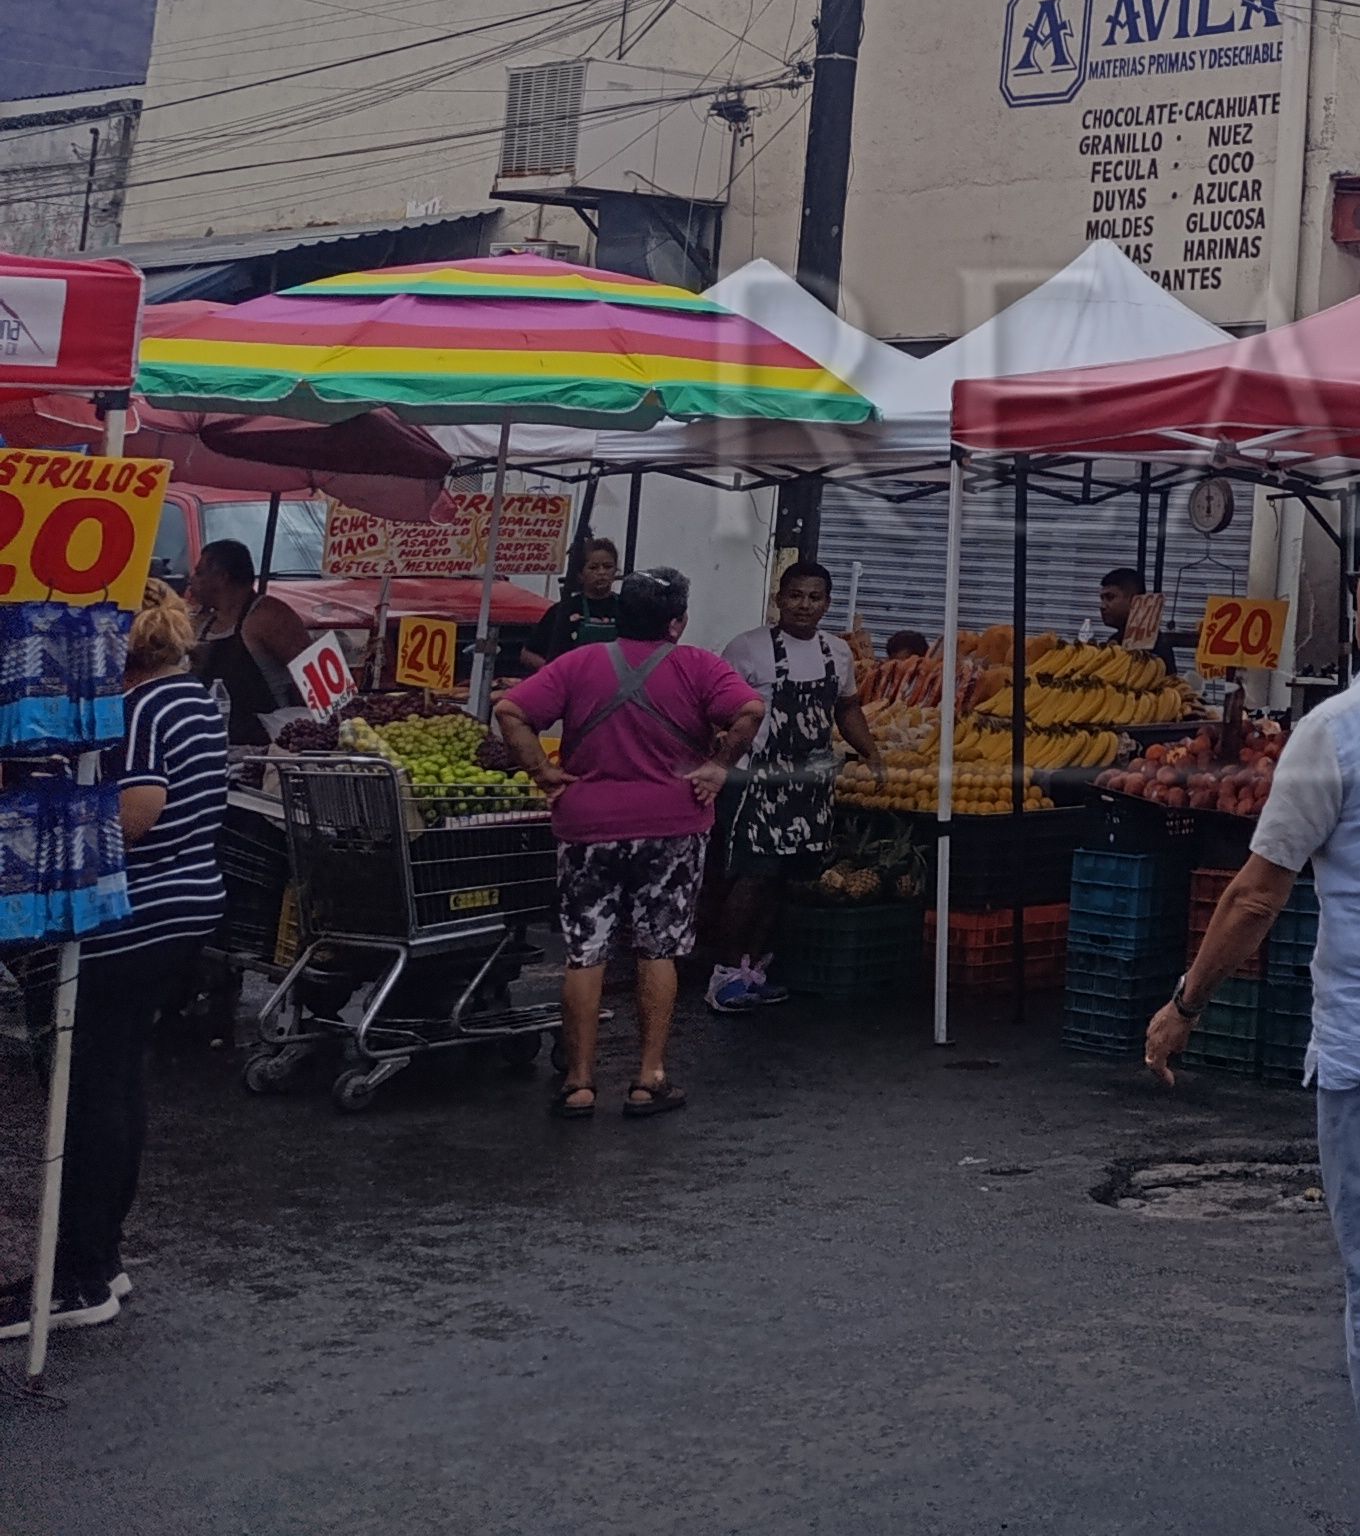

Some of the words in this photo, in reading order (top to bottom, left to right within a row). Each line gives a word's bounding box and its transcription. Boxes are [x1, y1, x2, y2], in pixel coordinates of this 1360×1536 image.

[1087, 55, 1146, 80] MATERIAS
[1149, 50, 1197, 75] PRIMAS
[1199, 49, 1208, 70] Y
[1208, 41, 1284, 70] DESECHABLE
[1082, 102, 1178, 131] CHOCOLATE
[1185, 92, 1281, 123] CACAHUATE
[1079, 130, 1163, 156] GRANILLO
[1208, 122, 1254, 148] NUEZ
[1090, 159, 1159, 183] FECULA
[1208, 151, 1255, 175] COCO
[1093, 187, 1147, 213] DUYAS
[1193, 179, 1263, 206] AZUCAR
[1086, 215, 1154, 241] MOLDES
[1186, 207, 1266, 233] GLUCOSA
[1183, 235, 1263, 262] HARINAS
[390, 527, 470, 539] PICADILLO
[496, 542, 550, 553] ORDITAS
[398, 547, 452, 558] HUEVO
